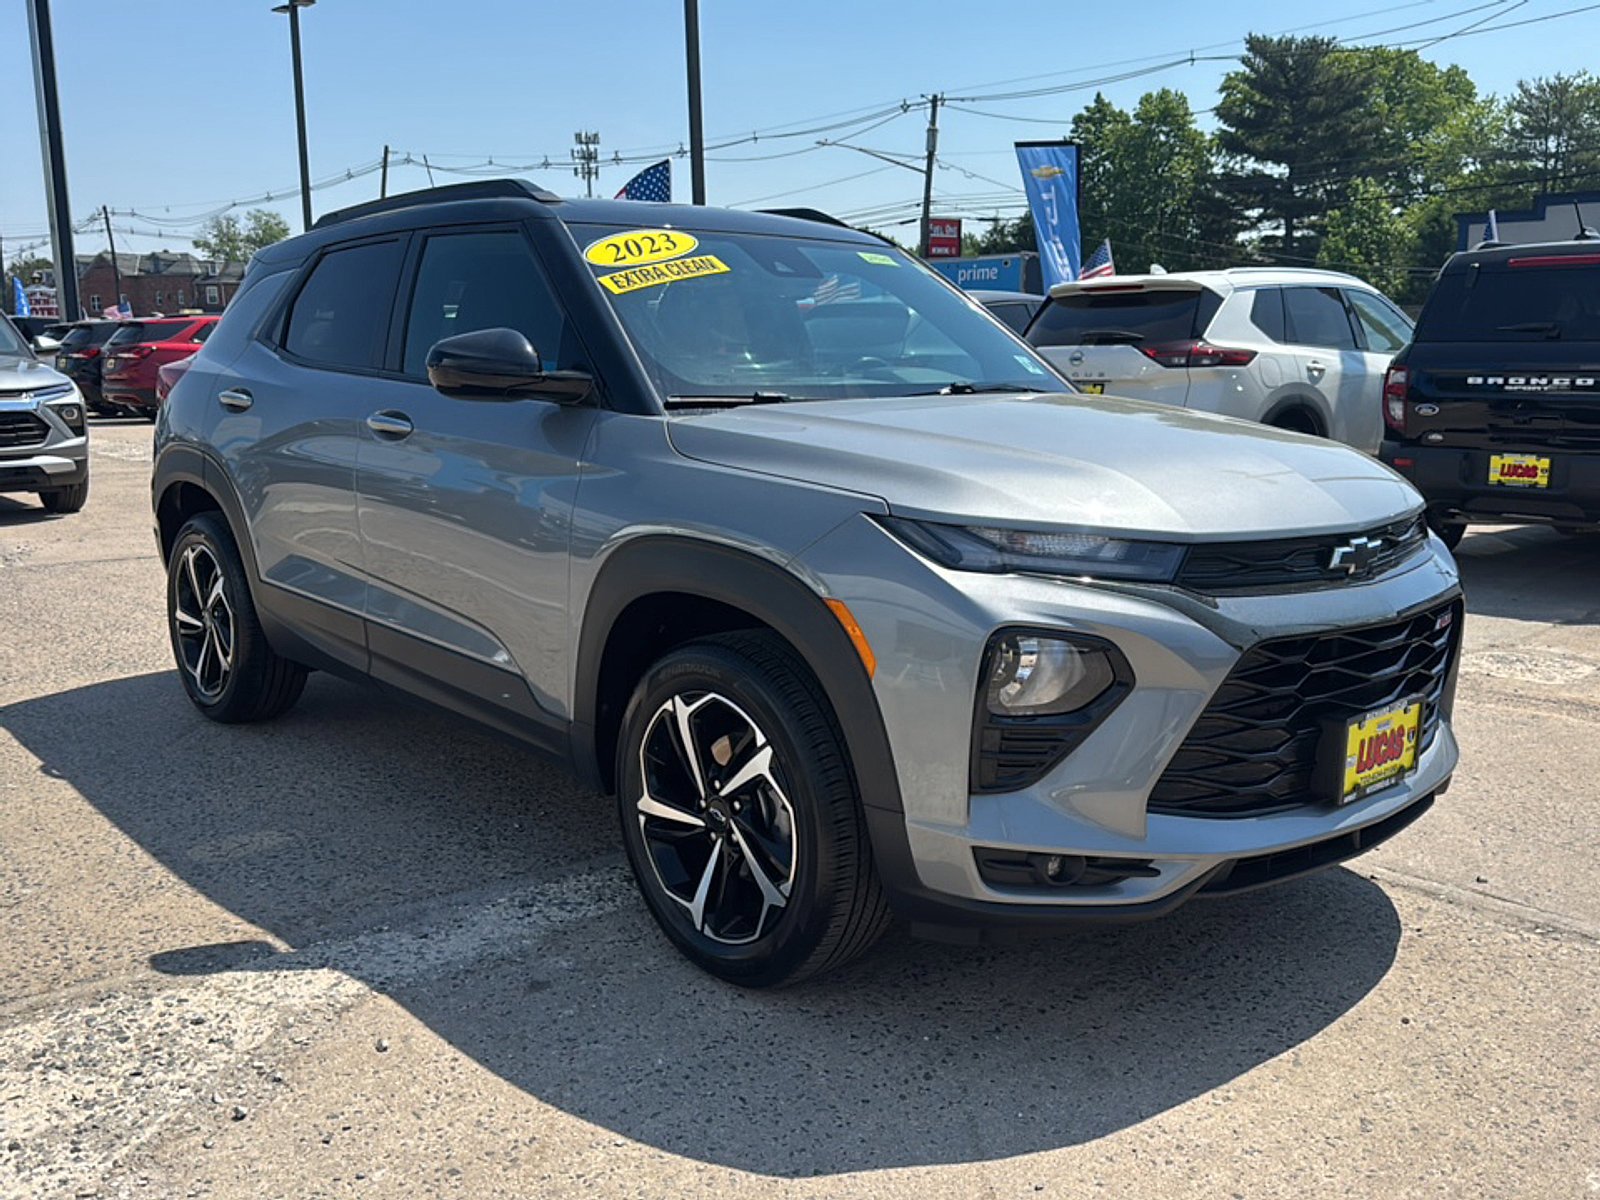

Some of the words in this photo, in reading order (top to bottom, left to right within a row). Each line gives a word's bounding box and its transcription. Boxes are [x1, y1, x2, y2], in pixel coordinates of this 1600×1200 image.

[605, 233, 677, 262] 2023
[610, 267, 666, 290] EXTRA
[667, 257, 717, 276] CLEAN
[958, 264, 998, 285] prime
[1466, 376, 1595, 386] BRONCO
[1499, 463, 1539, 479] LUCAS
[1356, 724, 1405, 774] LUCAS
